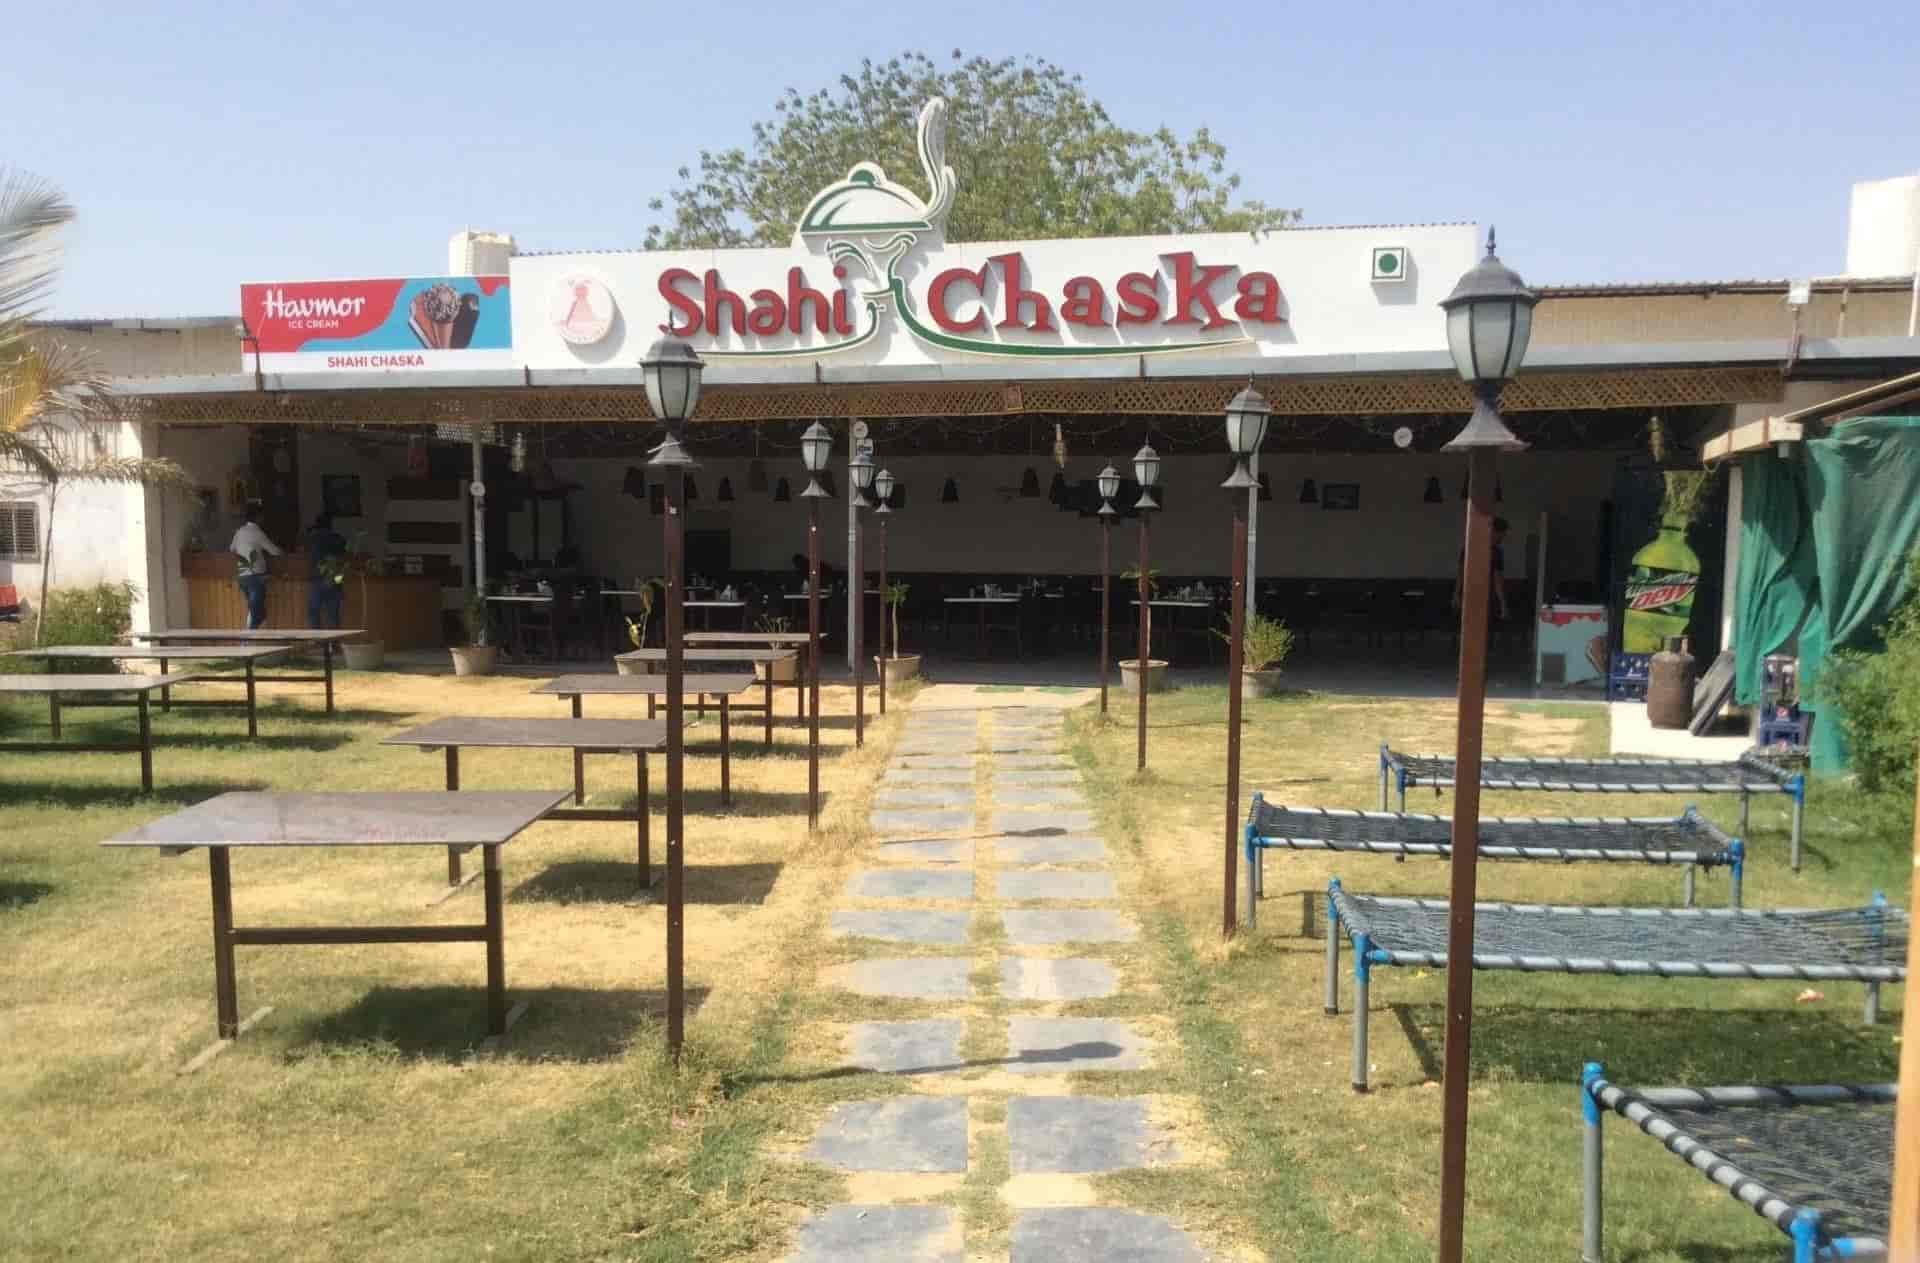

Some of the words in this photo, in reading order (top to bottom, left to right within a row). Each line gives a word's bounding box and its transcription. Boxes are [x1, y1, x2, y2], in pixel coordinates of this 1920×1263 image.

[263, 289, 366, 318] Havmor
[657, 265, 853, 337] Shahi
[928, 252, 1286, 333] Chaska
[288, 320, 303, 329] ICE
[306, 319, 339, 329] CREAM
[327, 357, 367, 368] SHAHI
[370, 355, 425, 367] CHASKA
